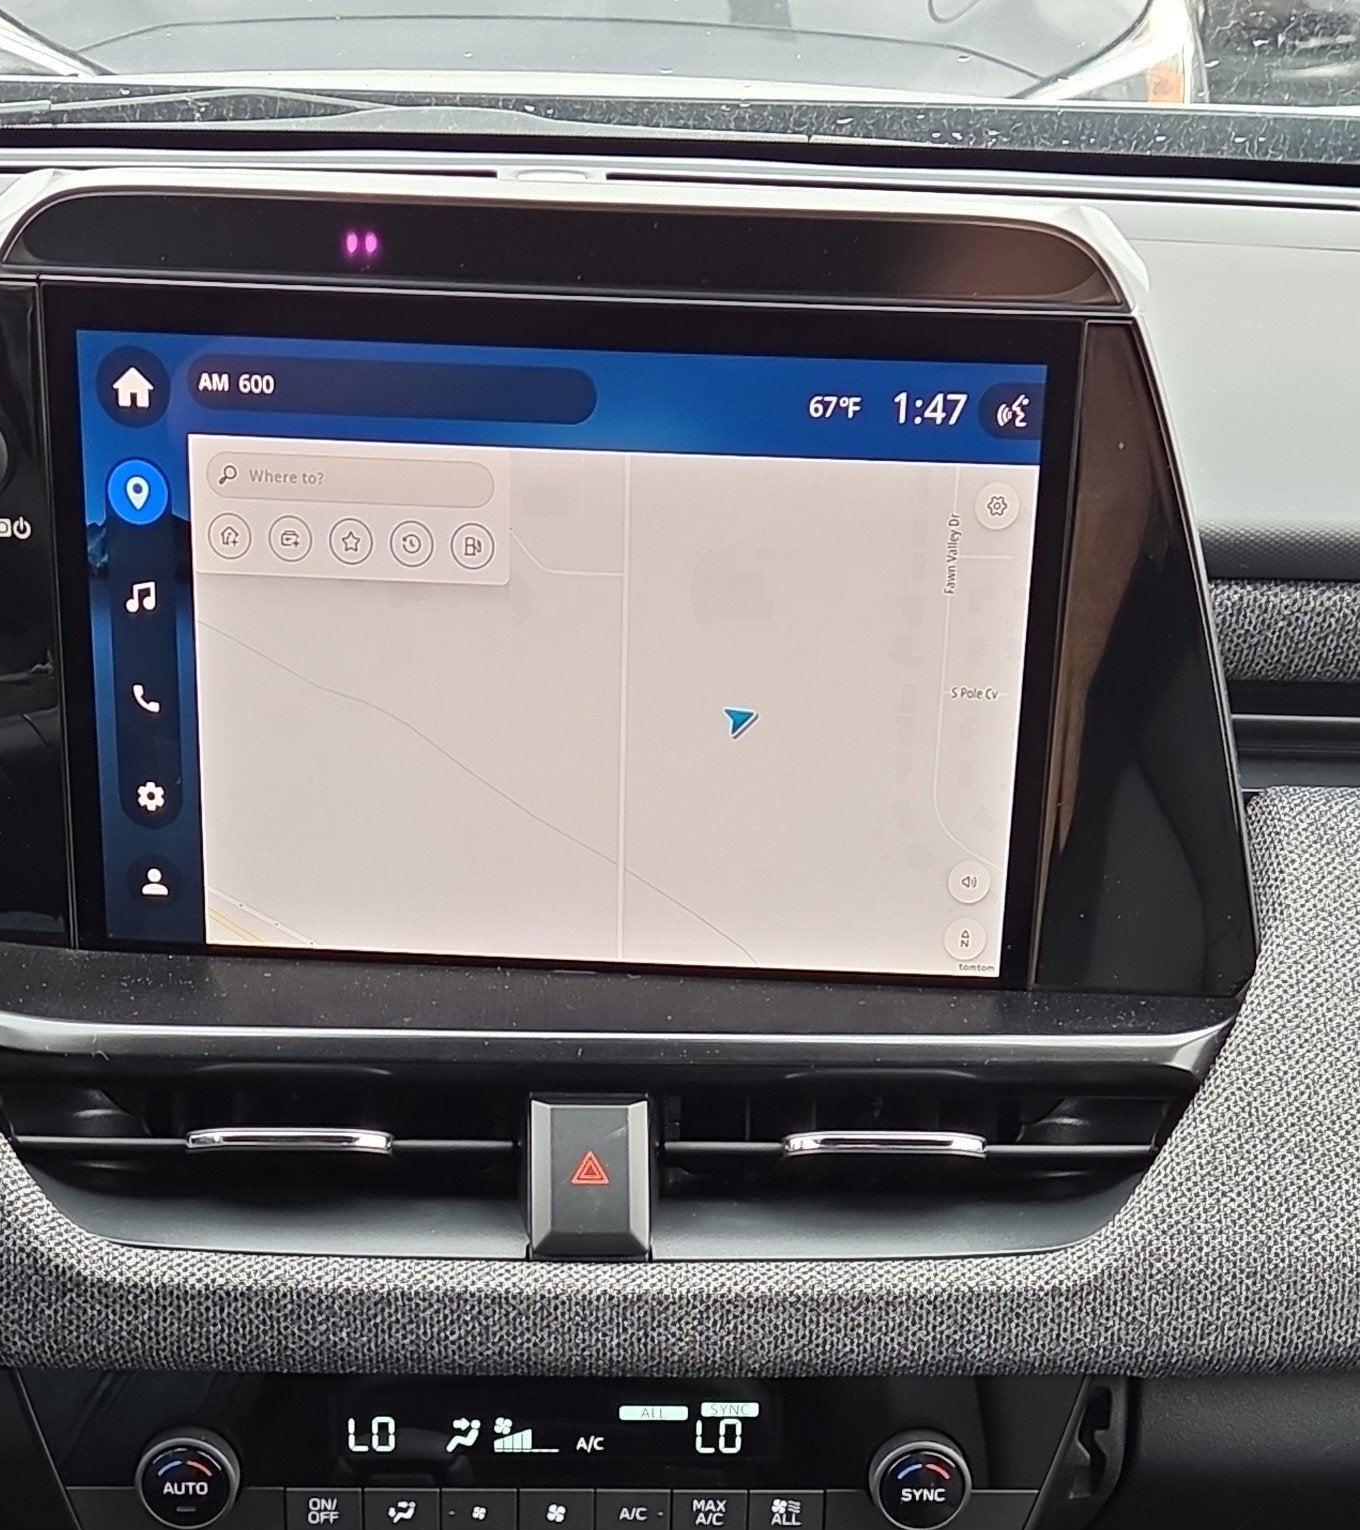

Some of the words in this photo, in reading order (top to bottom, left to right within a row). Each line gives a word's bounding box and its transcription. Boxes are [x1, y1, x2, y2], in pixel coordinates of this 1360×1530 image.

[198, 373, 229, 392] AM
[239, 374, 275, 394] 600
[809, 395, 862, 419] 67°F
[893, 391, 968, 426] 1:47
[248, 466, 299, 483] Where
[302, 469, 324, 486] to?
[948, 513, 960, 527] Dr
[946, 529, 962, 563] Valley
[944, 564, 956, 594] Fawn
[639, 1407, 667, 1419] ALL
[710, 1403, 749, 1417] SYNC
[576, 1436, 605, 1453] A/C
[162, 1482, 209, 1495] AUTO
[901, 1488, 946, 1502] SYNC
[308, 1497, 337, 1511] ON/
[692, 1499, 727, 1513] MAX
[307, 1511, 339, 1525] OFF
[619, 1507, 648, 1521] A/C
[695, 1512, 724, 1526] A/C
[770, 1512, 802, 1526] ALL
